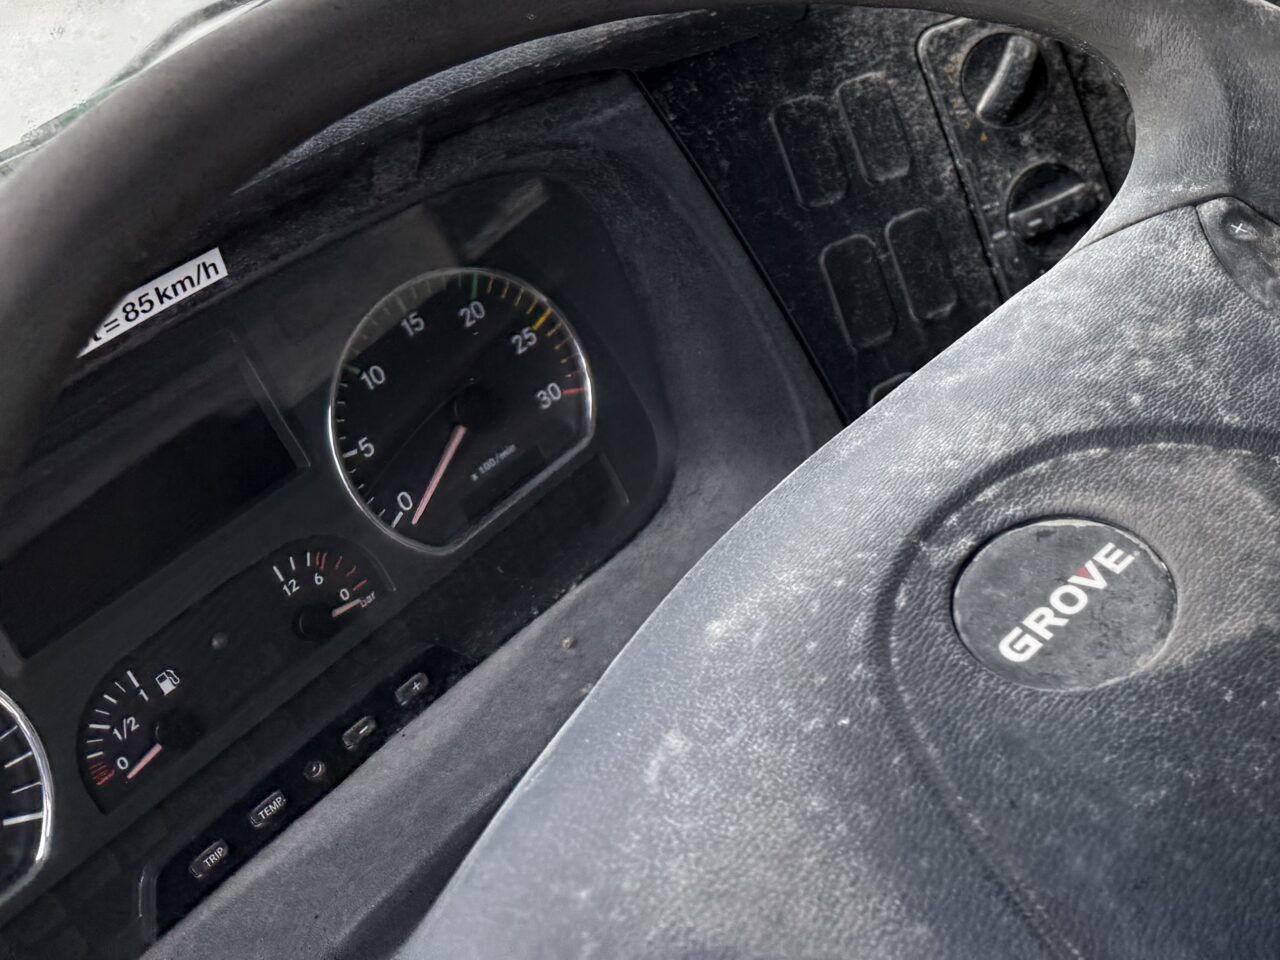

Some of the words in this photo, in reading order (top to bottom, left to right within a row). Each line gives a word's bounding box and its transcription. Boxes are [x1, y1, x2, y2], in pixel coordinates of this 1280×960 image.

[400, 314, 425, 337] 15
[458, 300, 486, 329] 20
[511, 329, 538, 355] 25
[360, 364, 386, 391] 10
[535, 382, 562, 410] 30
[358, 436, 375, 458] 5
[397, 491, 413, 512] 0
[282, 578, 300, 596] 12
[314, 572, 324, 585] 6
[339, 588, 350, 601] 0
[998, 542, 1135, 662] GROVE
[138, 689, 149, 701] 1
[112, 716, 140, 740] 1/2
[116, 756, 129, 770] 0
[203, 846, 226, 868] TRIP
